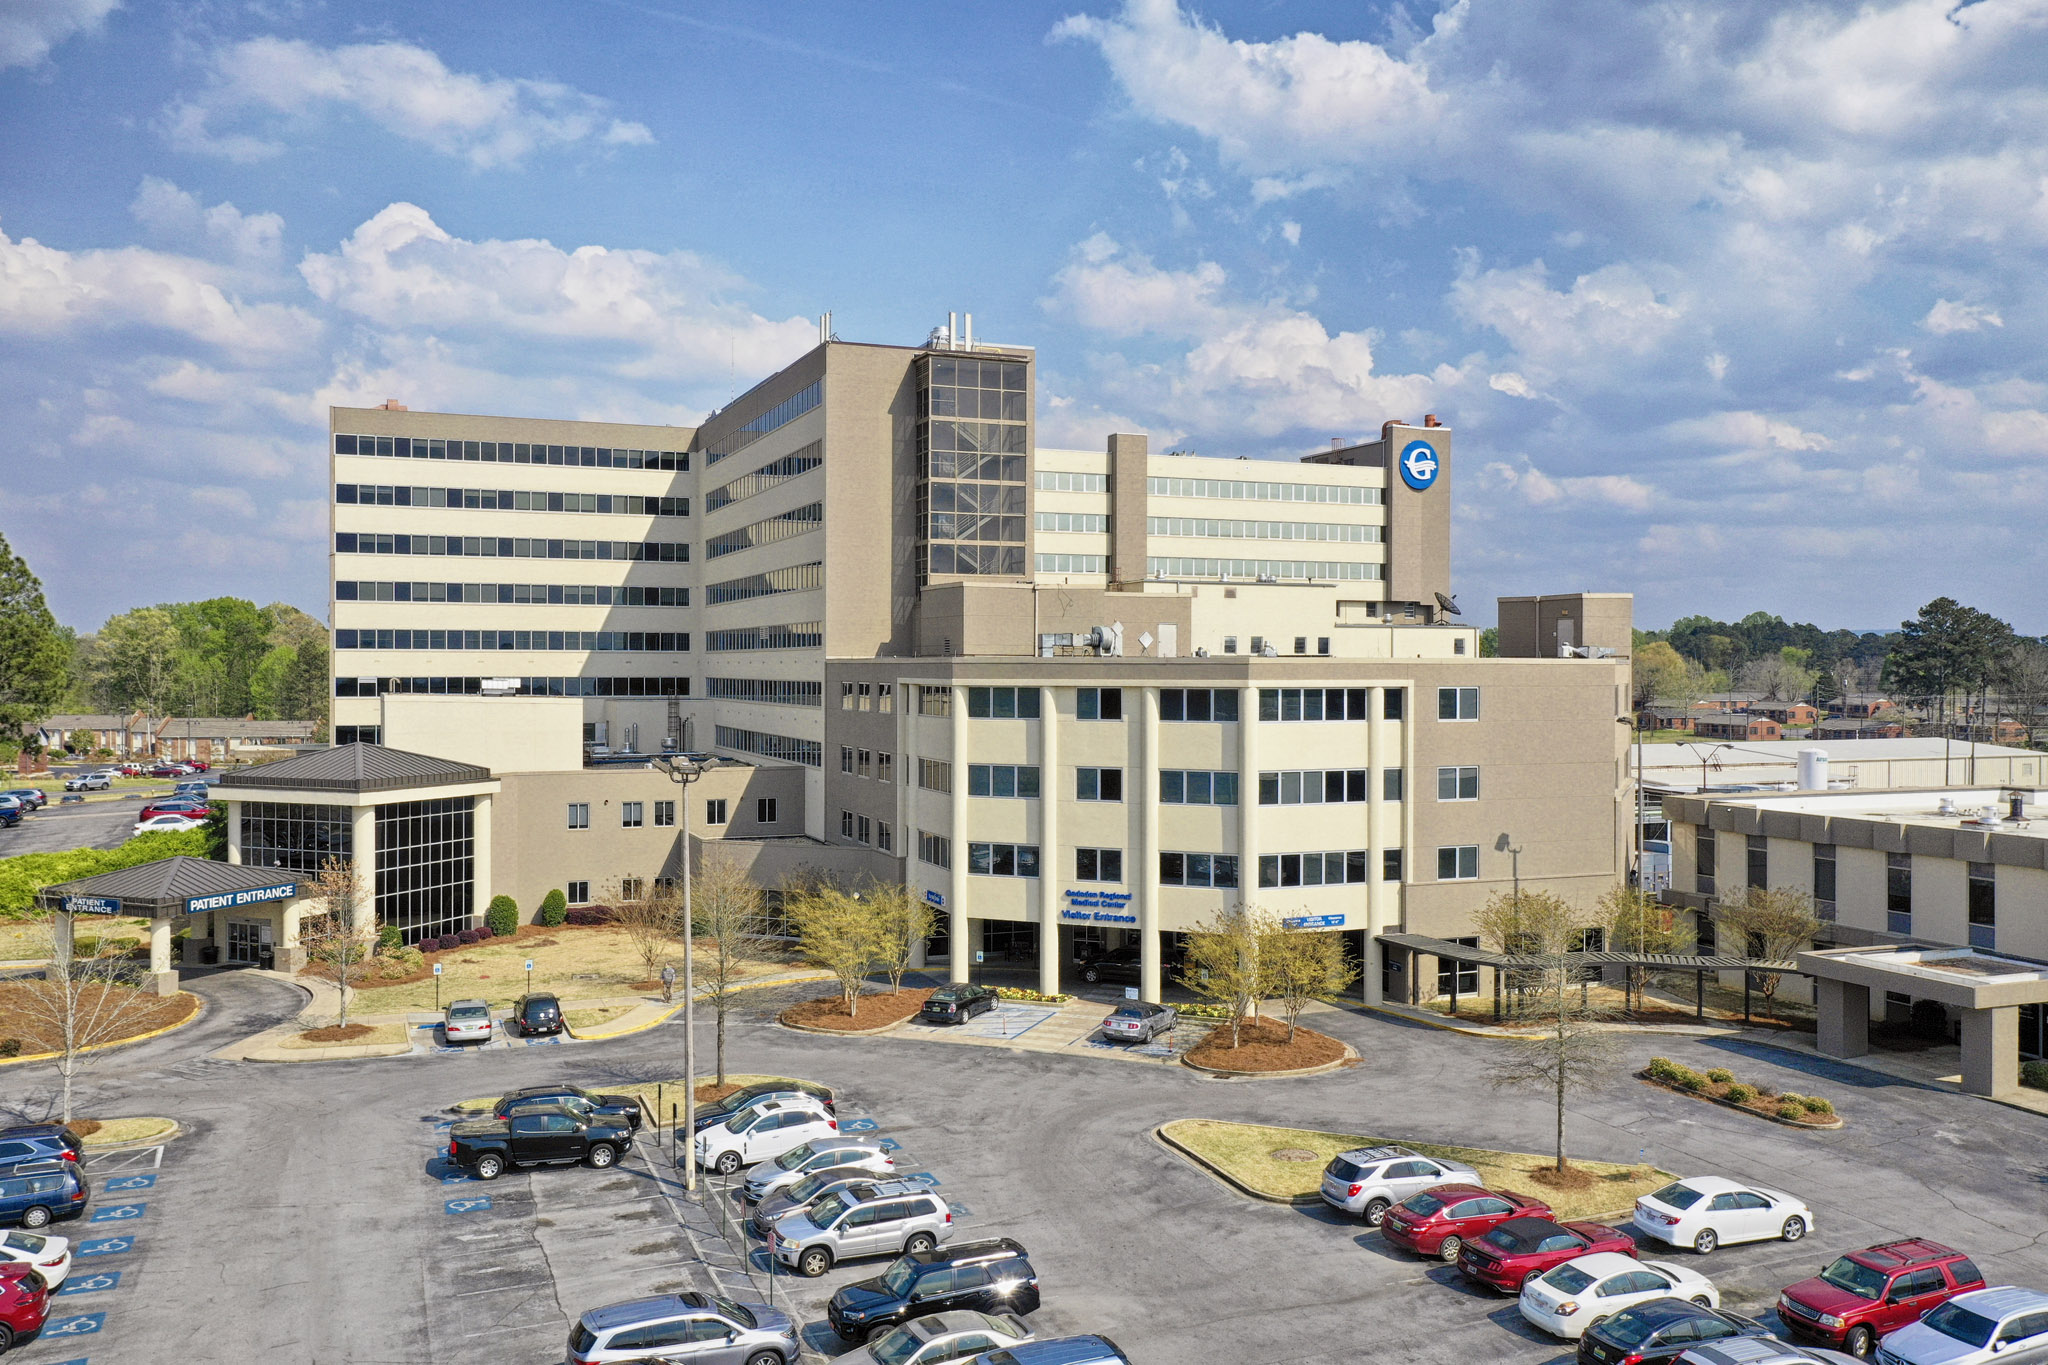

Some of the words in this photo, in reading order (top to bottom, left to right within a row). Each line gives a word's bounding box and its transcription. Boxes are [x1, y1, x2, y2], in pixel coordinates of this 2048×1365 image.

[190, 894, 234, 912] PATIENT
[236, 885, 294, 904] ENTRANCE
[1099, 891, 1133, 900] Regional
[71, 897, 106, 907] PATIENT
[1071, 898, 1100, 907] Medical
[1101, 900, 1127, 909] Center
[65, 903, 113, 914] ENTRANCE
[1061, 910, 1091, 919] Visitor
[1093, 912, 1136, 923] Entrance
